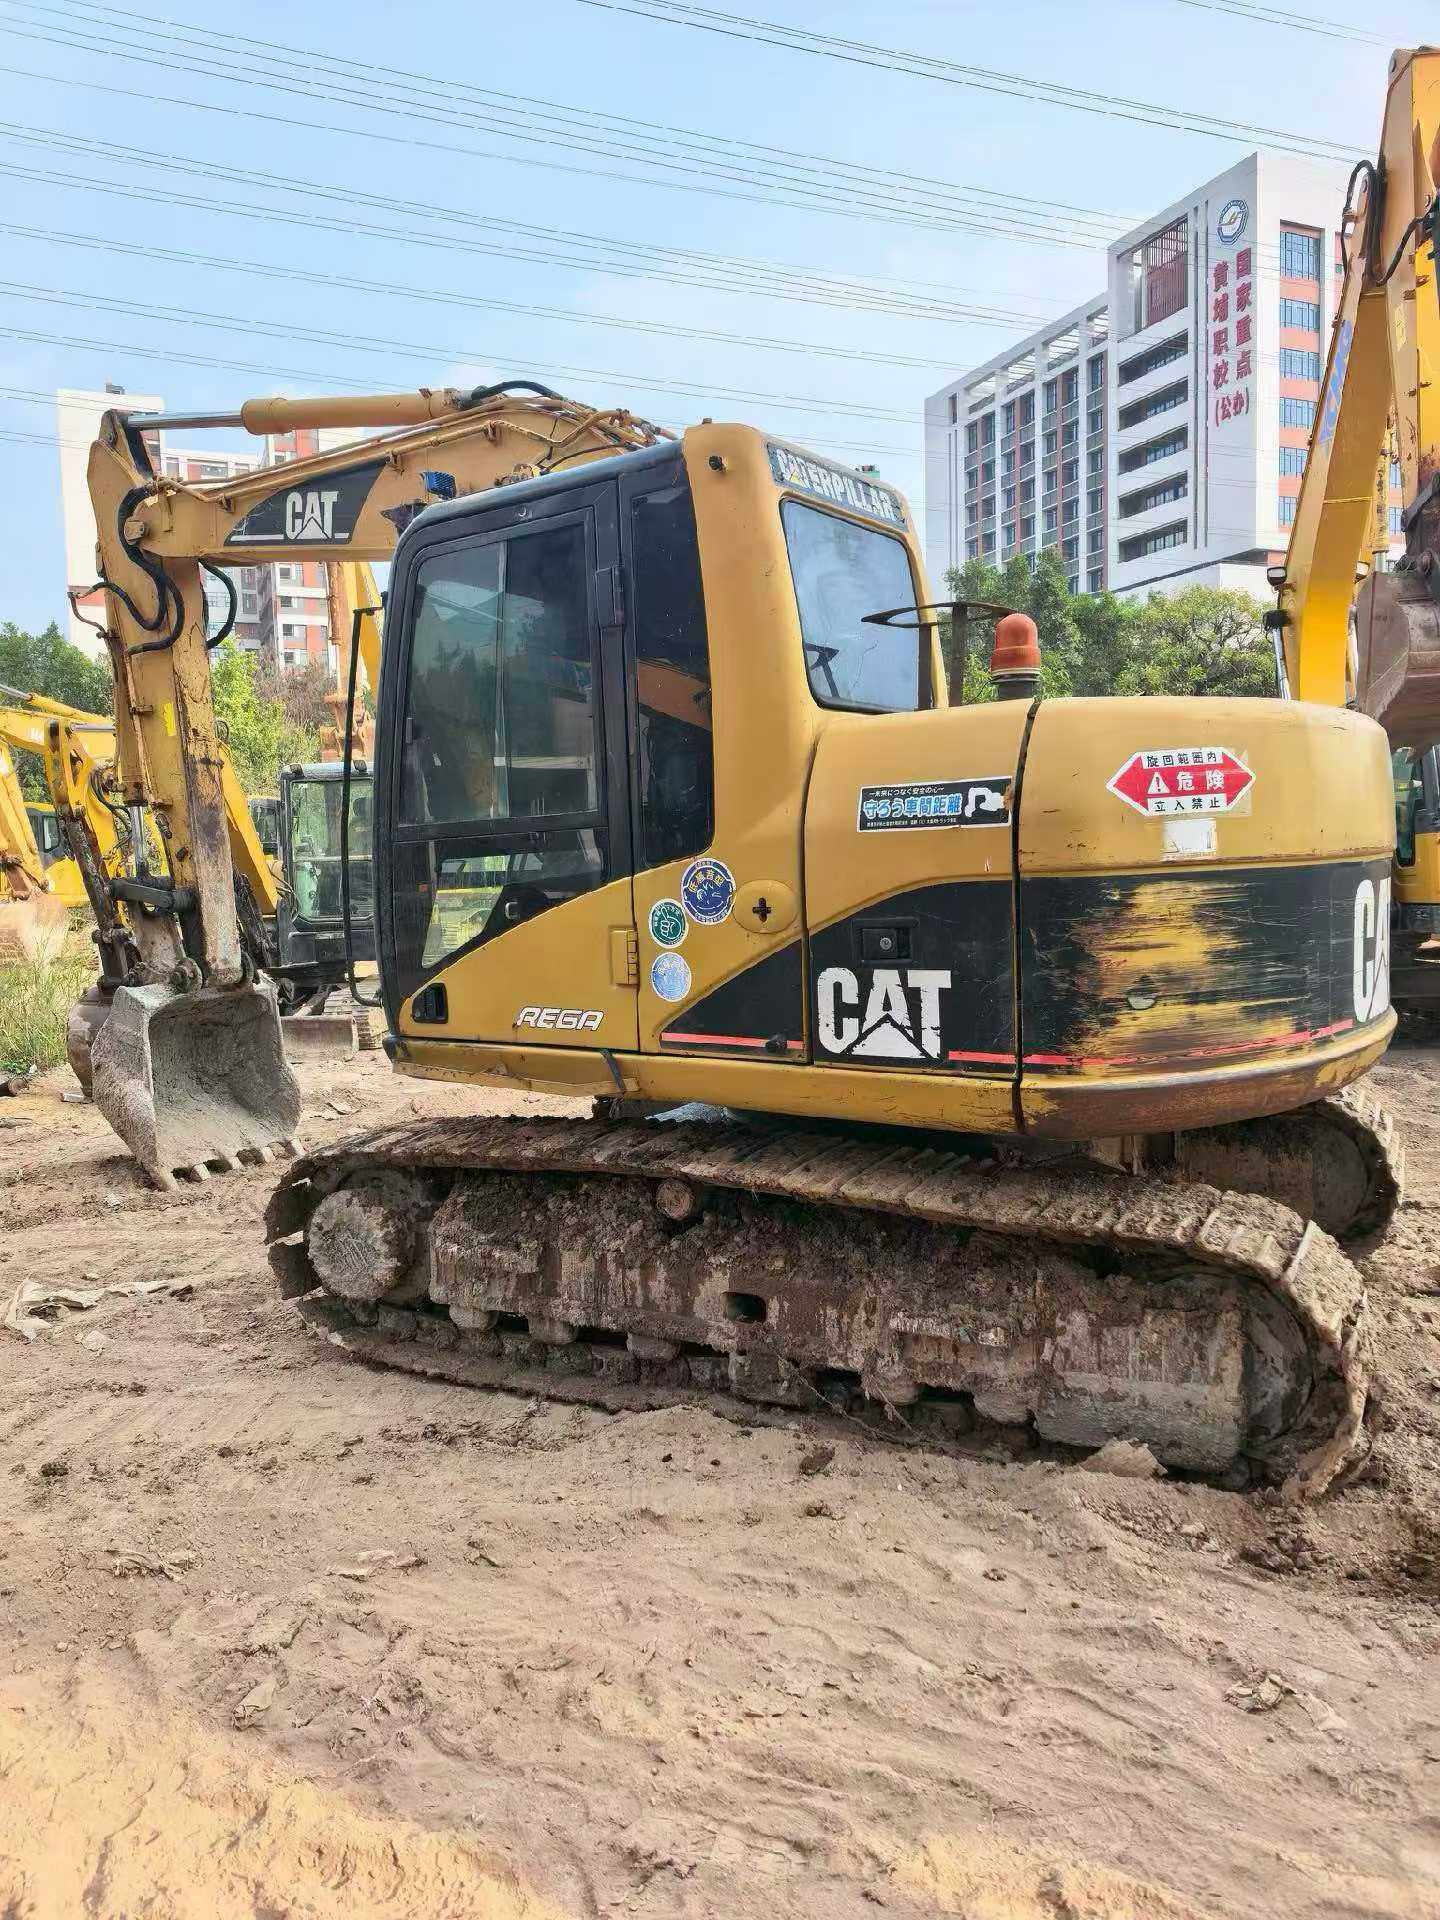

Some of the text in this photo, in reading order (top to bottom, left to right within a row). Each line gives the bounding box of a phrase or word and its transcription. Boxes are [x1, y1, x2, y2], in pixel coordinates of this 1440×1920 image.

[1213, 260, 1229, 390] 黄埔职校
[1236, 247, 1252, 380] 国家重点
[285, 491, 339, 540] CAT
[1147, 751, 1217, 767] 旋回範囲内
[1176, 770, 1225, 791] 危険
[863, 793, 962, 819] 守ろう車間距離
[1154, 797, 1221, 812] 立入禁止
[1353, 877, 1391, 1023] CA
[517, 1007, 604, 1031] REGA
[817, 967, 952, 1059] CAT
